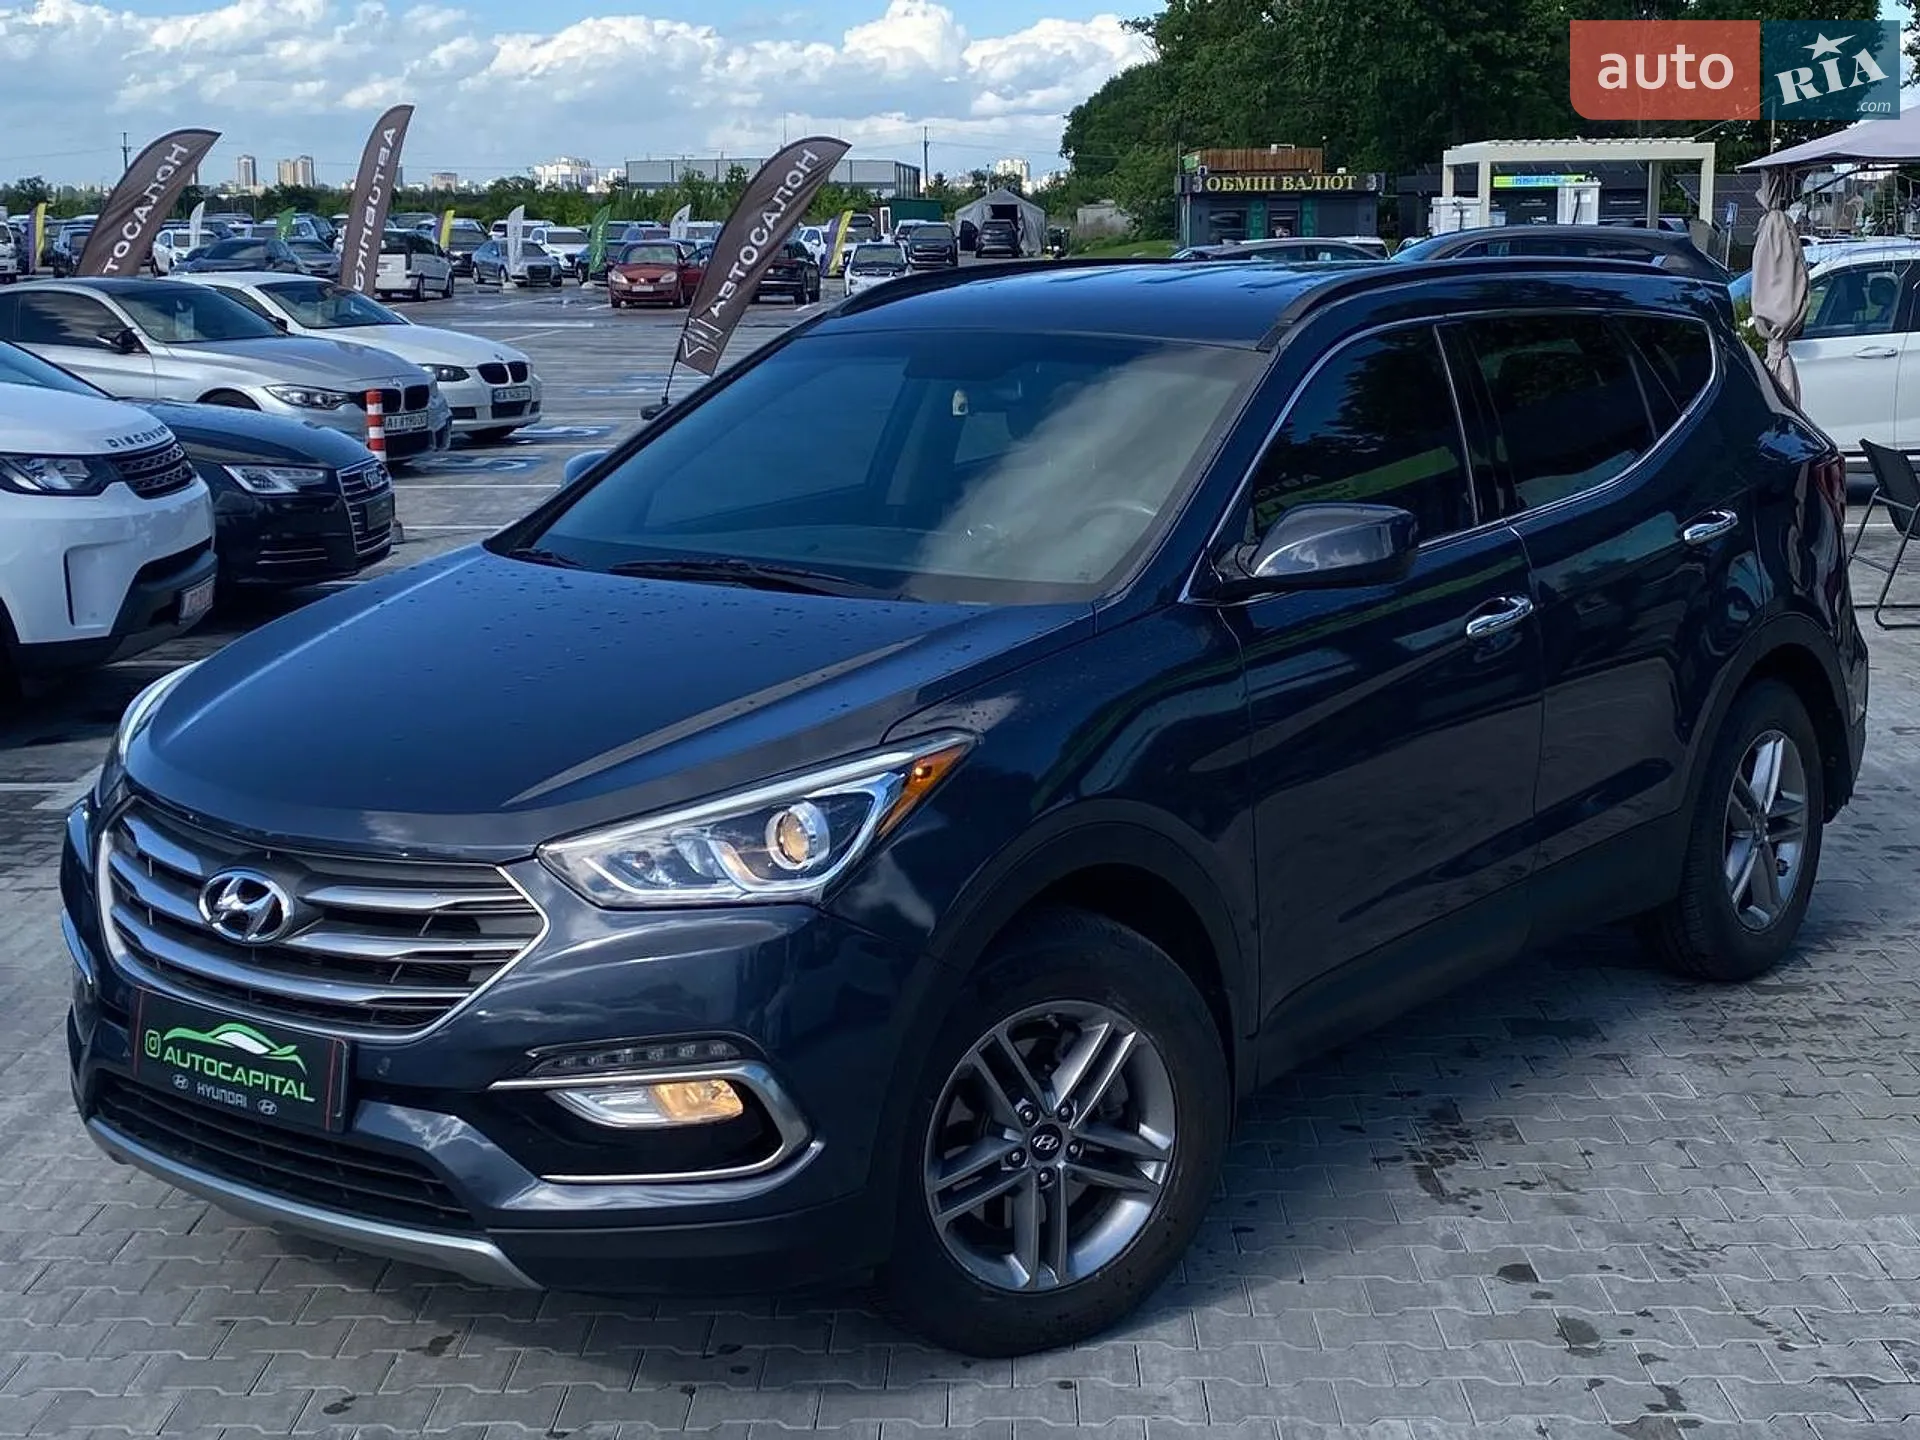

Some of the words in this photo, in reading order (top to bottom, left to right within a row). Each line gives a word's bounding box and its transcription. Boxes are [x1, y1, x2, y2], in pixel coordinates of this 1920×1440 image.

[1281, 174, 1357, 191] ВАЛЮТ
[709, 149, 819, 318] АВТОСАЛОН
[163, 1046, 316, 1103] AUTOCAPITAL
[197, 1081, 248, 1109] HYUNDAI
